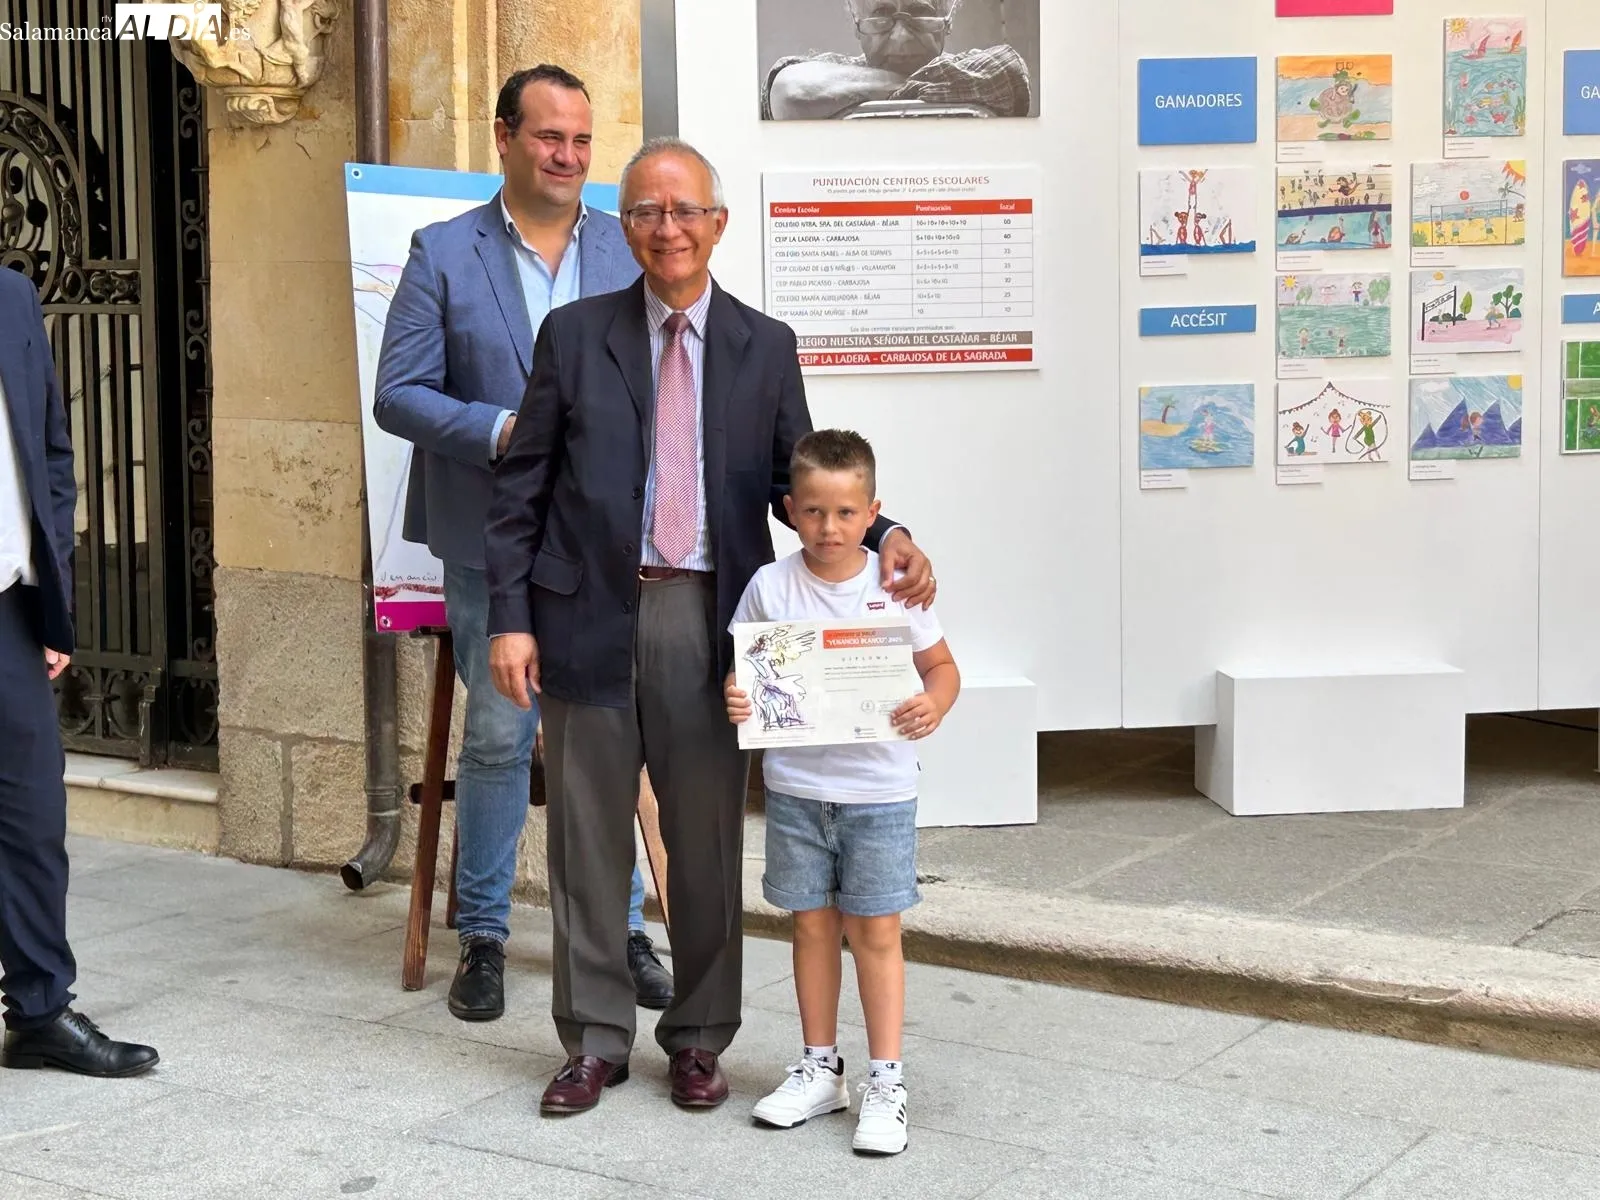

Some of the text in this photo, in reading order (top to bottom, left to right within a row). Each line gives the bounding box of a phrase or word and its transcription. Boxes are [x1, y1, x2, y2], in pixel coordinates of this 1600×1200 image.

[1155, 94, 1242, 108] GANADORES
[813, 176, 990, 186] PUNTUACIÓN CENTROS ESCOLARES
[1170, 309, 1227, 327] ACCÉSIT
[796, 337, 827, 347] OLEGIO
[830, 336, 871, 346] NUESTRA
[874, 334, 910, 345] SEÑORA
[914, 336, 930, 344] DEL
[932, 332, 980, 343] CASTAÑAR
[990, 330, 1017, 342] BÉJAR
[799, 356, 820, 364] CEIP
[835, 354, 870, 363] LADERA
[880, 353, 933, 362] CARBAJOSA
[936, 352, 947, 361] DE
[950, 352, 961, 360] LA
[964, 351, 1007, 360] SAGRADA
